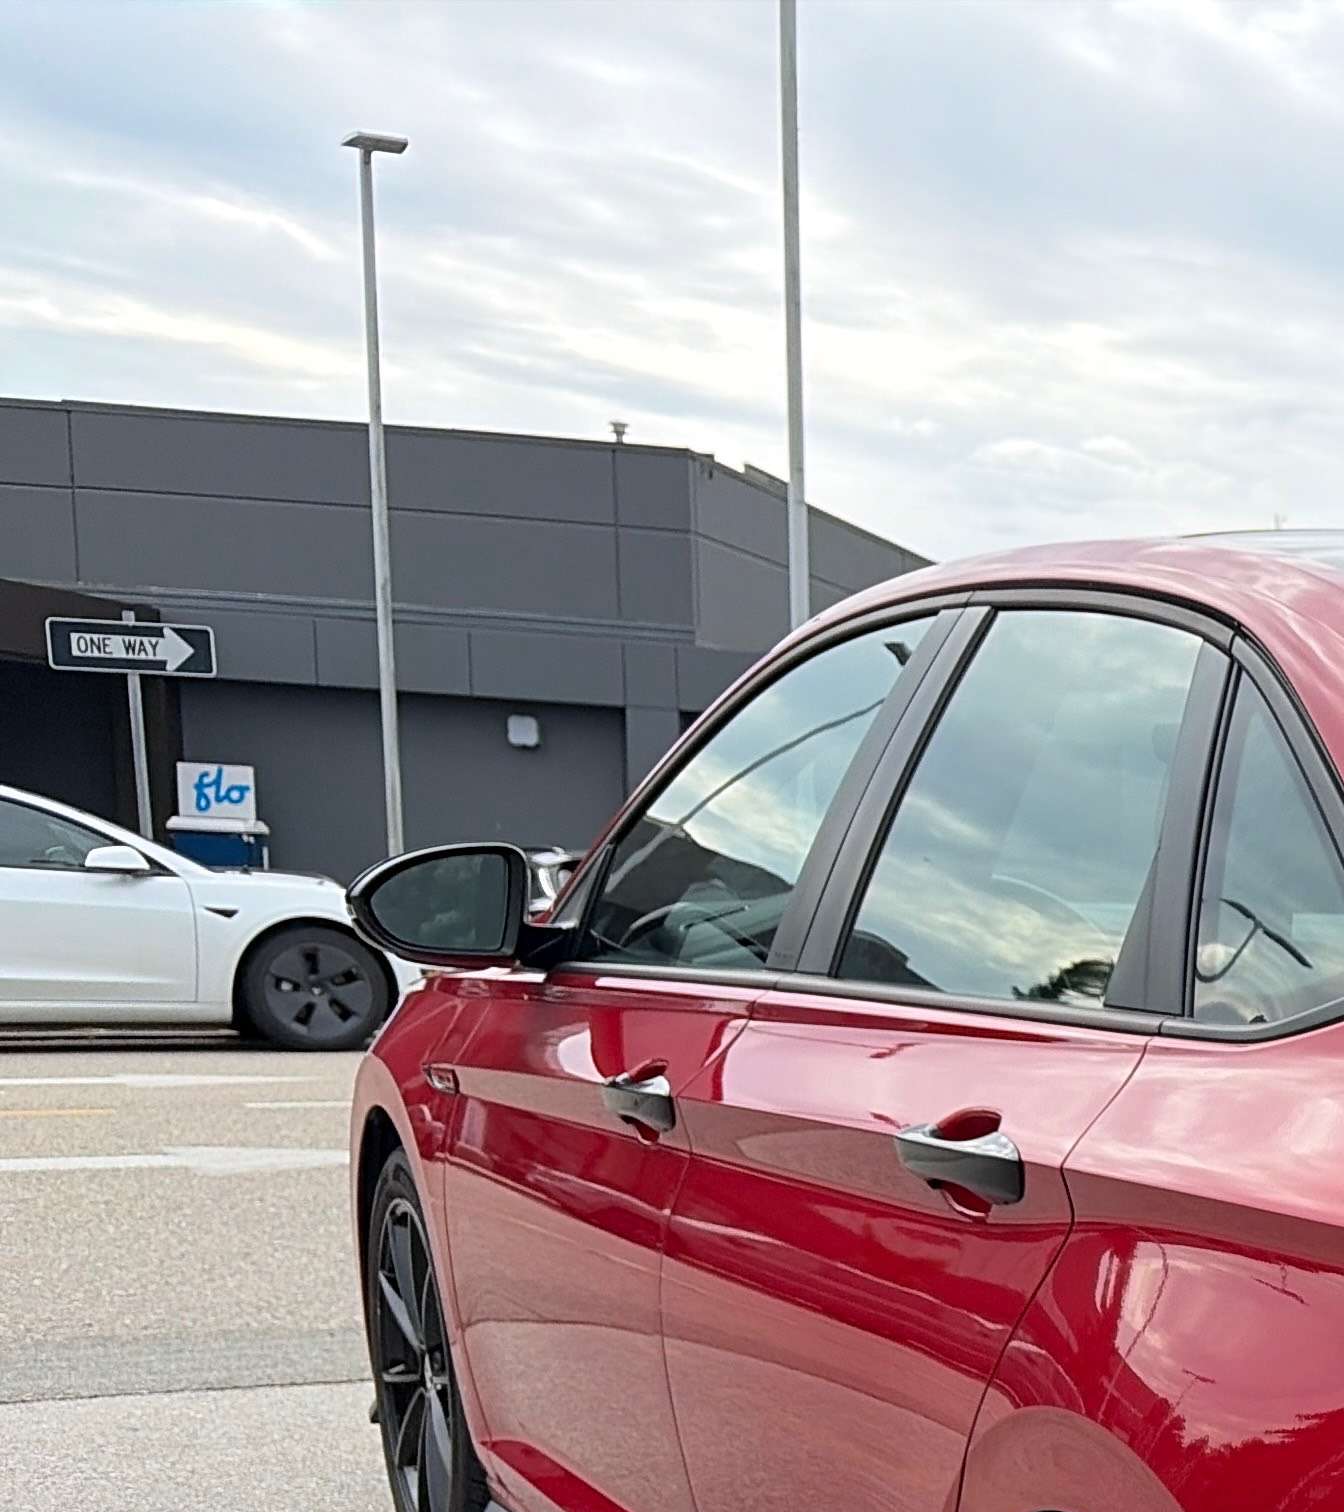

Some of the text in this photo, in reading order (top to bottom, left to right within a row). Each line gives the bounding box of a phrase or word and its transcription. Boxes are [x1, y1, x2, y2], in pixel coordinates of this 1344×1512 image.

[76, 634, 160, 658] ONE WAY
[193, 766, 250, 813] flo
